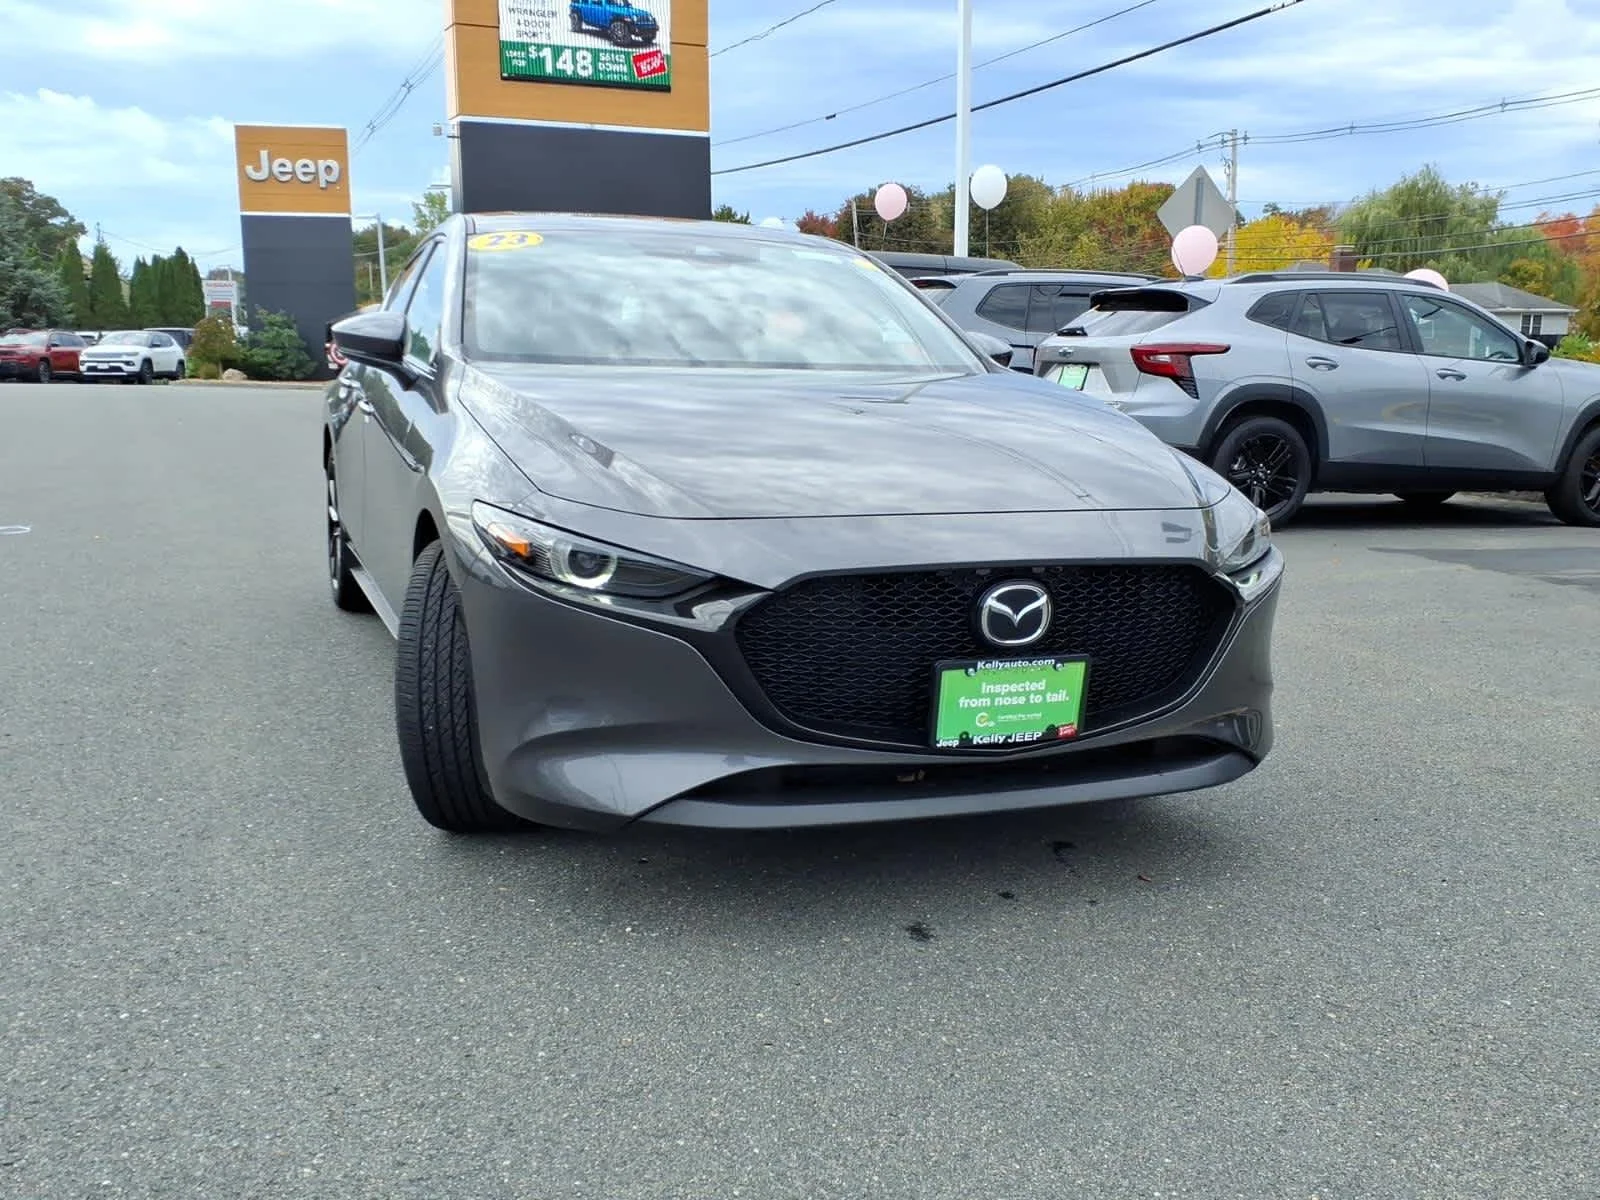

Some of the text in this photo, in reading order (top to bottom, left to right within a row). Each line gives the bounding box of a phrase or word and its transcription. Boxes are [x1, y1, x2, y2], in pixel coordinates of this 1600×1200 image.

[508, 7, 557, 18] WRANGLER
[528, 45, 593, 77] $148
[244, 149, 340, 189] Jeep
[976, 658, 1056, 672] Kellyauto.com
[981, 679, 1046, 697] Inspected
[958, 689, 1070, 709] from nose to tail.
[936, 738, 960, 748] Jeep
[972, 731, 1043, 745] Kelly JEEP
